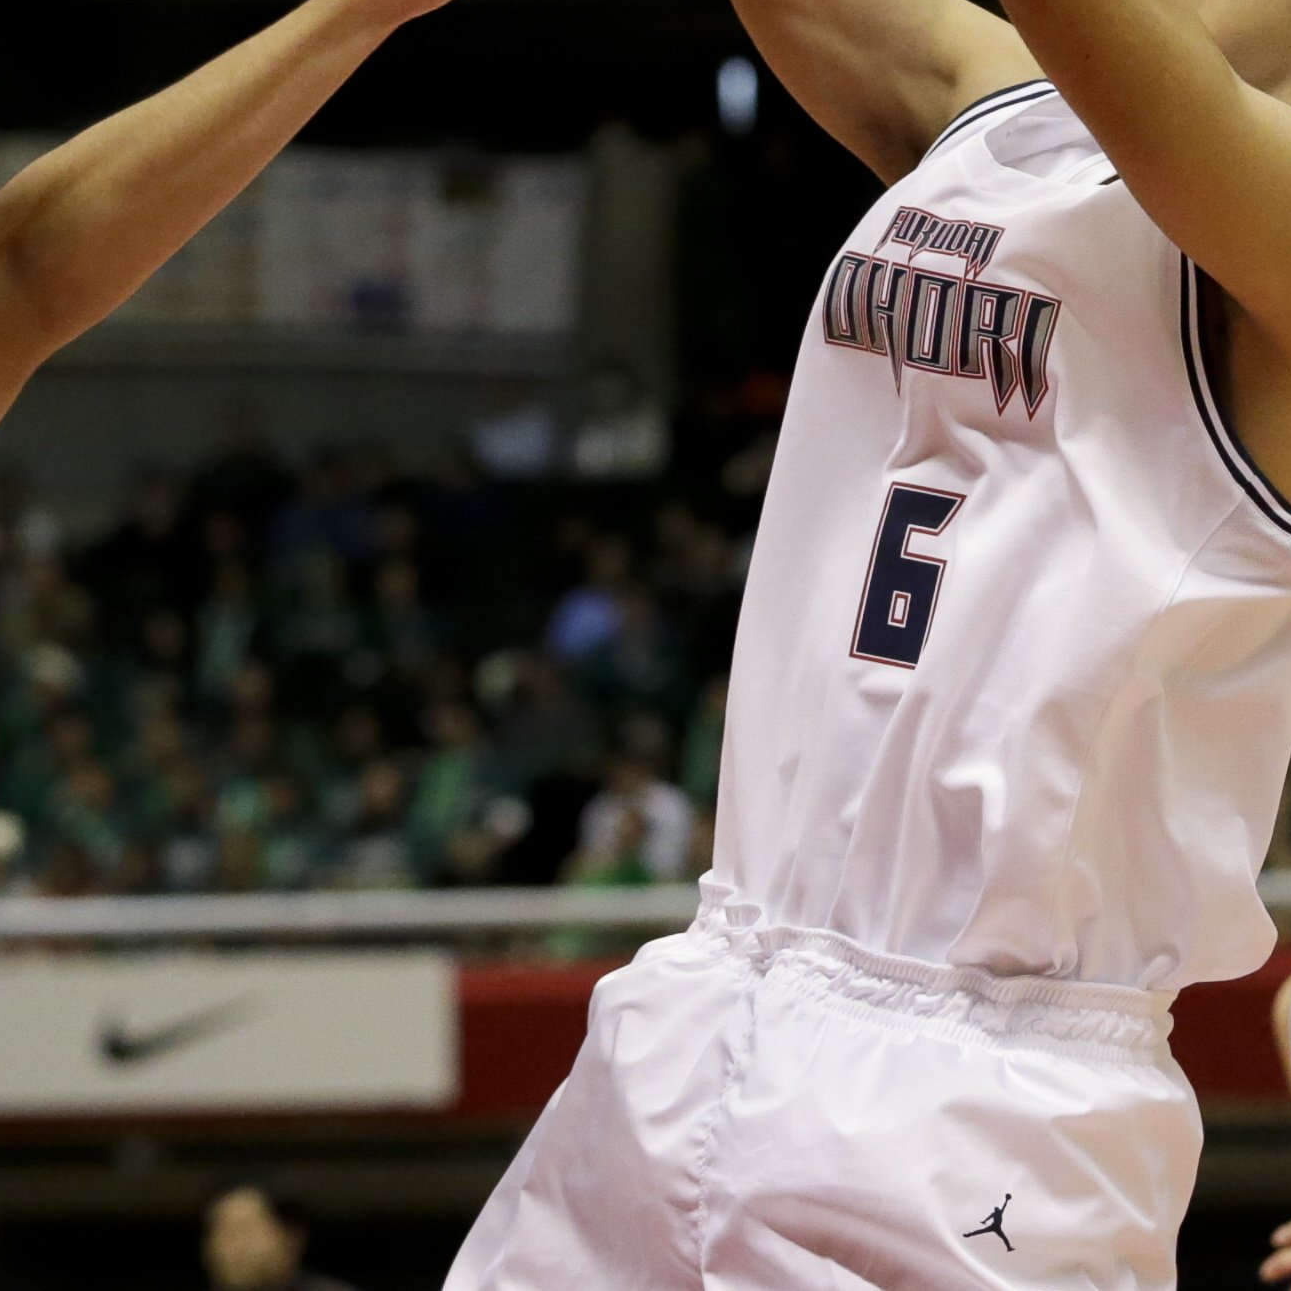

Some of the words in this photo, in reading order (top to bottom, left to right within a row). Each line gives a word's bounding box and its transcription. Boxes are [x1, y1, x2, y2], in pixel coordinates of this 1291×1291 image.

[873, 205, 1006, 279] FUKUDAI
[823, 251, 1062, 422] OHORI
[849, 481, 967, 670] 6
